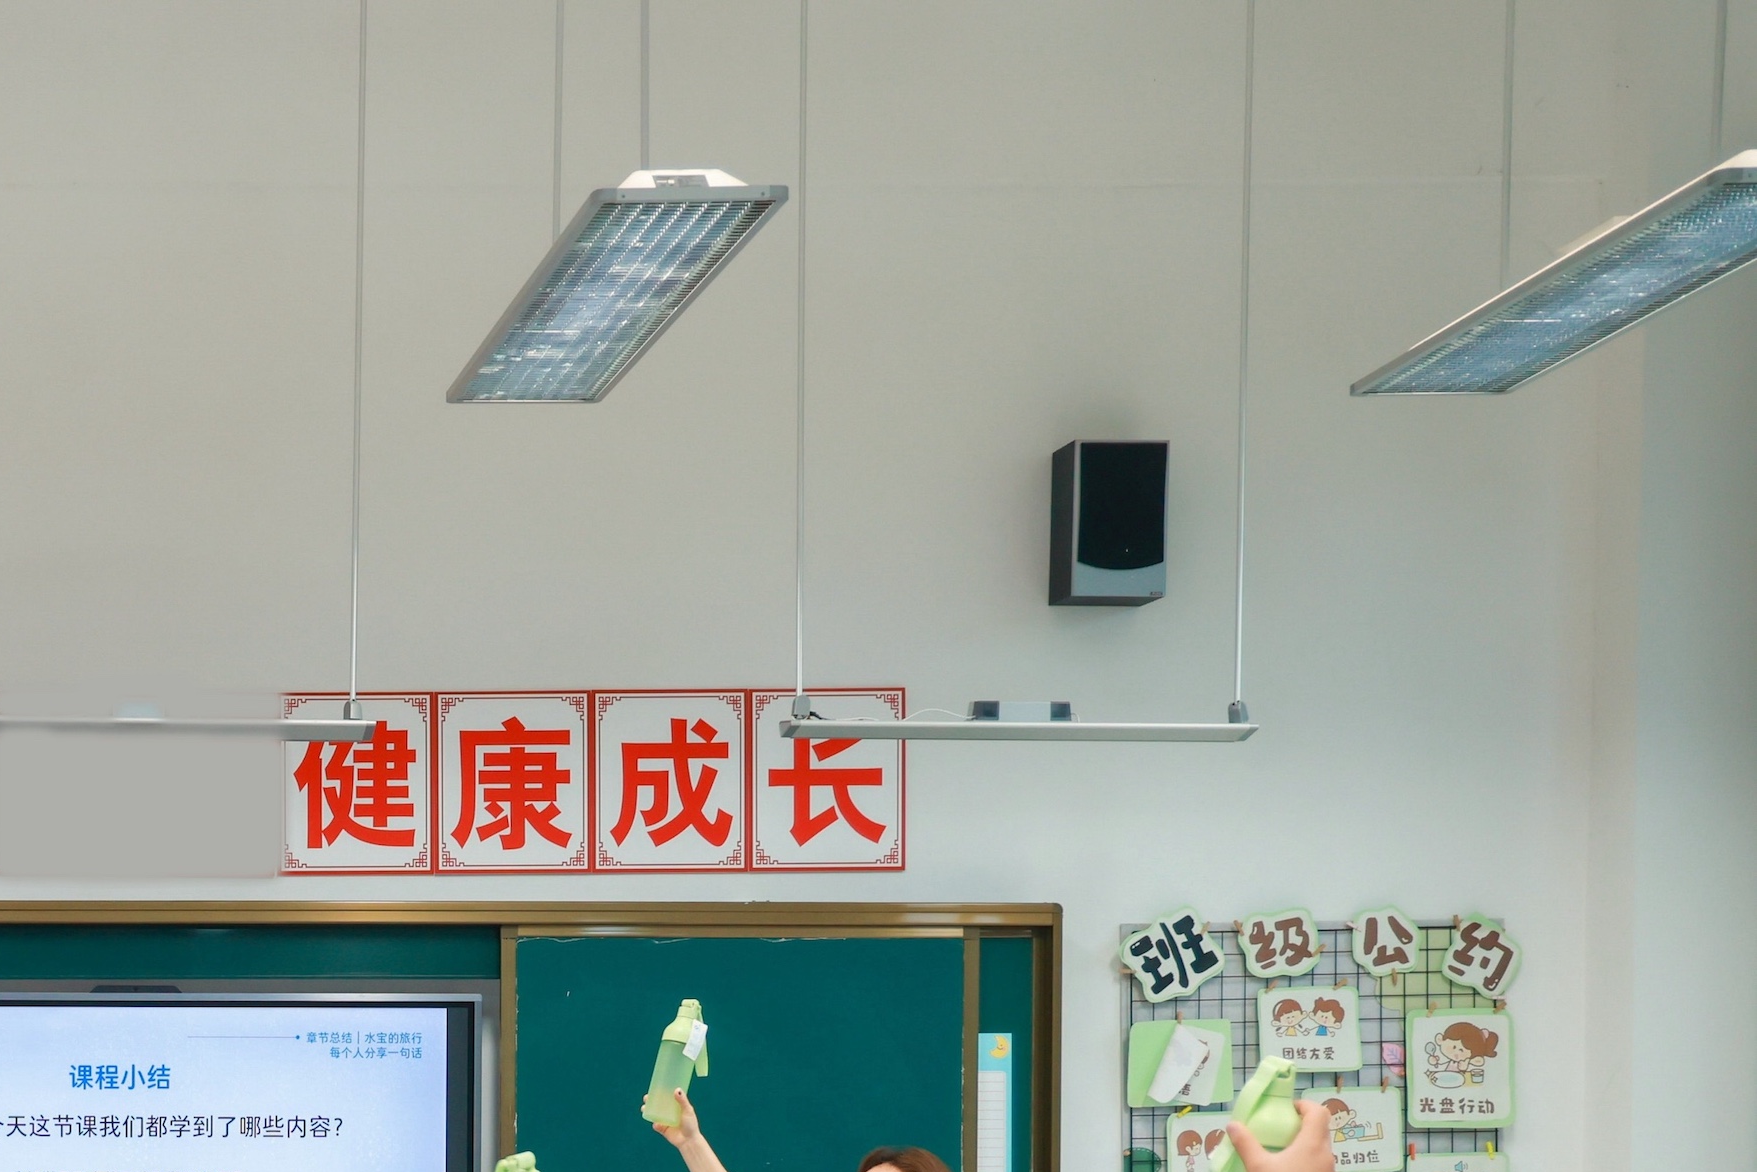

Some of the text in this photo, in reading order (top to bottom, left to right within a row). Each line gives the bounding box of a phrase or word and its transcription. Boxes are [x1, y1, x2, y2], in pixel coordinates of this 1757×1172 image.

[293, 716, 887, 850] 健康成长
[1128, 914, 1514, 993] 班级公约
[306, 1031, 423, 1045] 章节总结 水宝的旅行
[329, 1046, 423, 1060] 每个人分享一句话
[69, 1063, 171, 1091] 课程小结
[1419, 1096, 1495, 1115] 光盘行动
